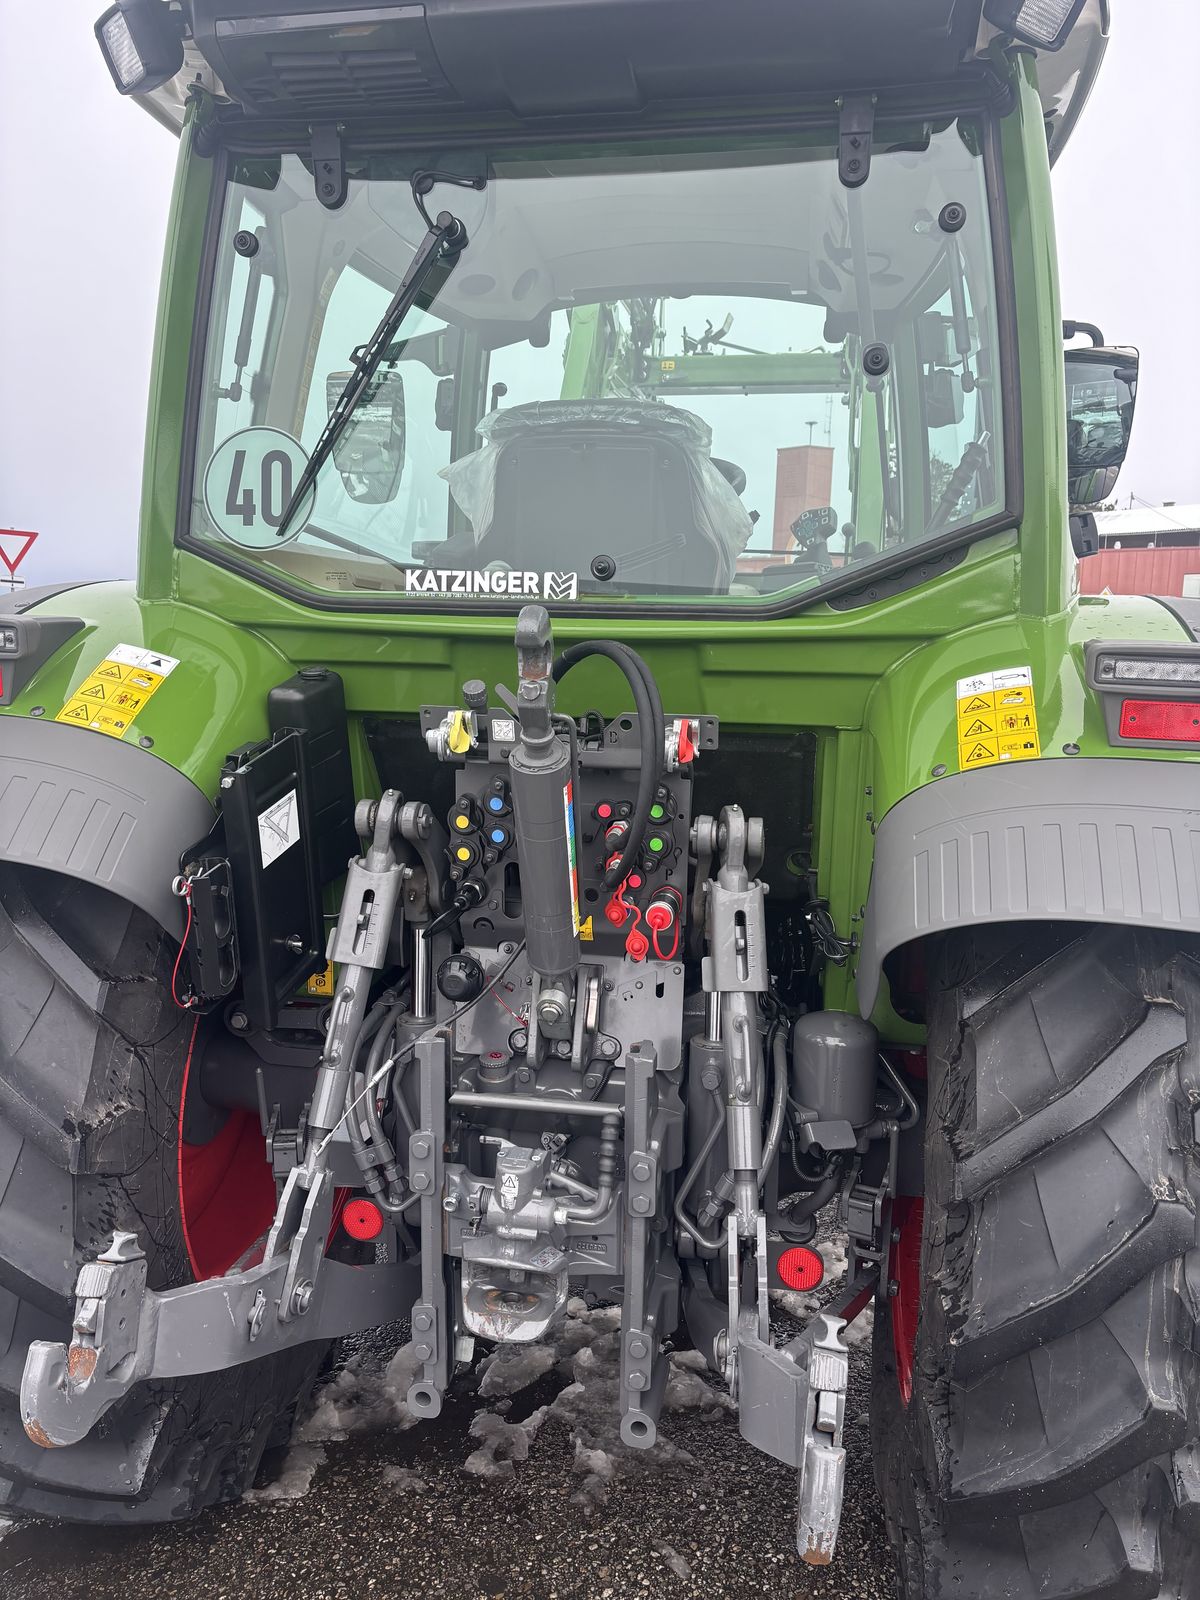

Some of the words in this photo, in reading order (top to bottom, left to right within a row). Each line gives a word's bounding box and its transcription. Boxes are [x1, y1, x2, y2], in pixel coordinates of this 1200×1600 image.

[226, 449, 292, 527] 40
[405, 569, 540, 594] KATZINGER
[665, 868, 674, 881] P
